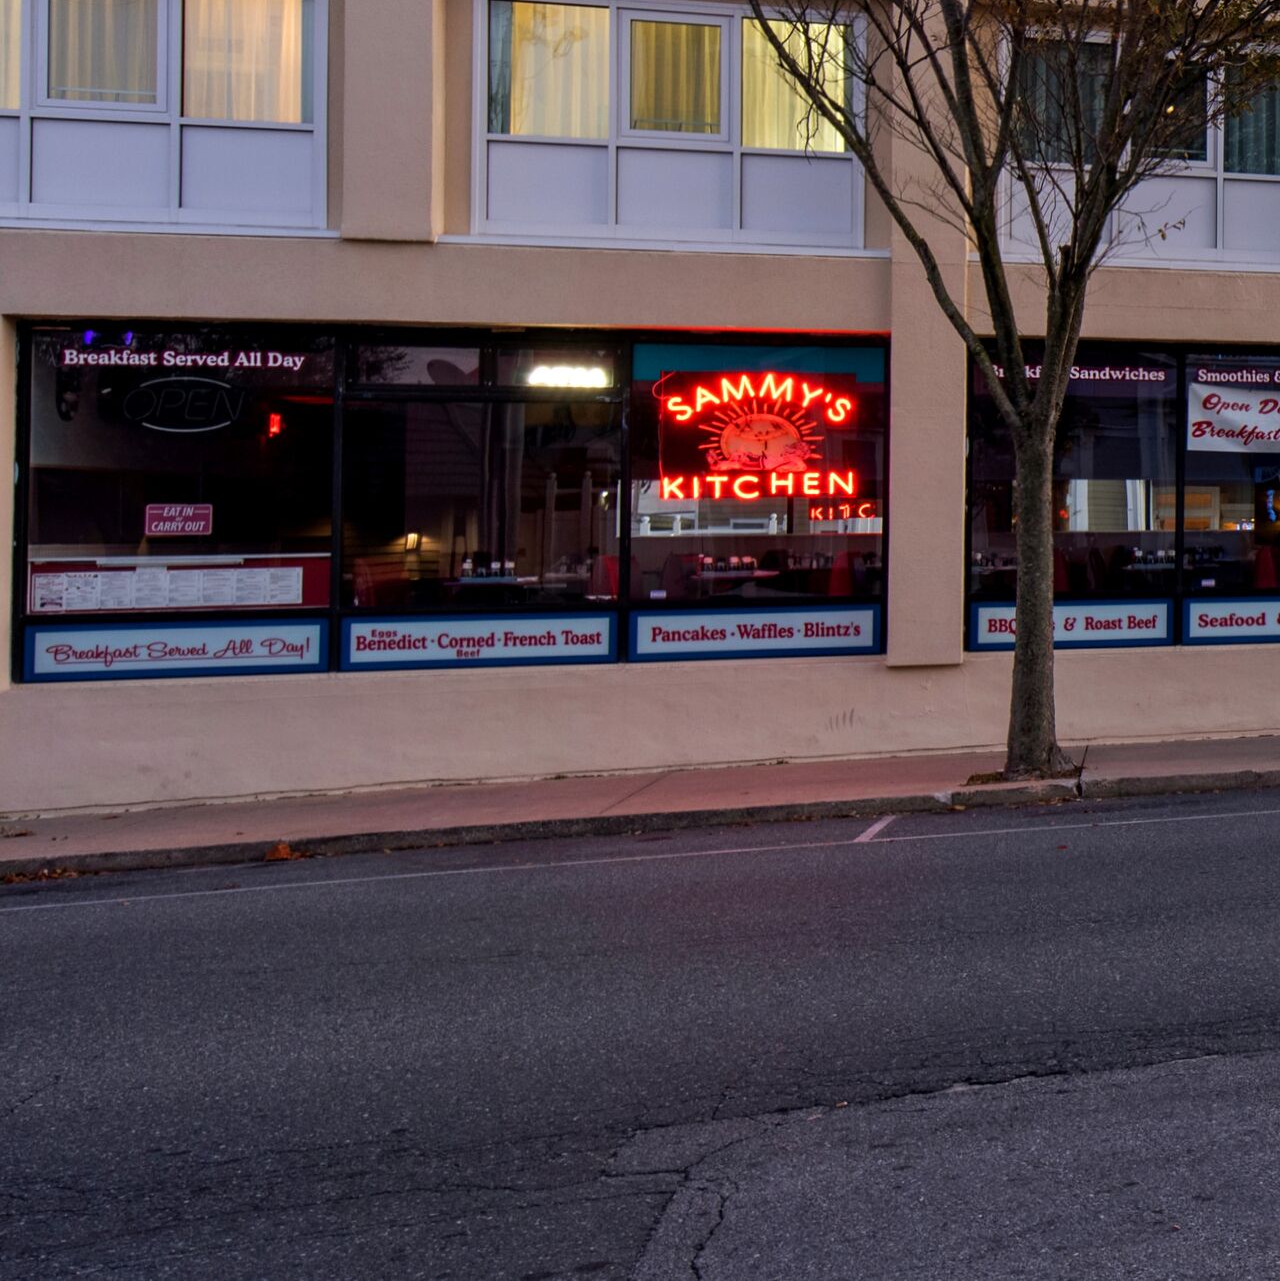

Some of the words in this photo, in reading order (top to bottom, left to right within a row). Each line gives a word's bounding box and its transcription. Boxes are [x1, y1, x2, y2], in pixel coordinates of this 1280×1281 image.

[63, 349, 157, 366] Breakfast
[163, 350, 230, 366] Served
[234, 351, 262, 367] All
[268, 352, 305, 370] Day
[1069, 366, 1166, 381] Sandwiches
[1198, 369, 1270, 383] Smoothies
[123, 388, 246, 420] OPEN
[667, 374, 851, 422] SAMMY'S
[1202, 393, 1252, 415] Open
[663, 472, 853, 499] KITCHEN
[163, 507, 181, 517] EAT
[182, 507, 194, 517] IN
[151, 521, 184, 531] CARRY
[184, 521, 206, 531] OUT
[1063, 617, 1077, 631] &
[1084, 616, 1123, 631] Roast
[1127, 615, 1158, 629] Beef
[1198, 613, 1266, 628] Seafood
[355, 634, 428, 651] Benedict
[437, 632, 496, 649] Corned
[503, 630, 557, 647] French
[561, 630, 602, 645] Toast
[371, 629, 398, 638] Eggs
[651, 625, 726, 642] Pancakes
[736, 623, 794, 640] Waffles
[803, 622, 861, 638] Blintz's
[46, 644, 140, 667] Breakfast
[146, 642, 208, 660] Served
[213, 639, 253, 658] All
[260, 637, 310, 660] Day!
[456, 648, 480, 658] Beef
